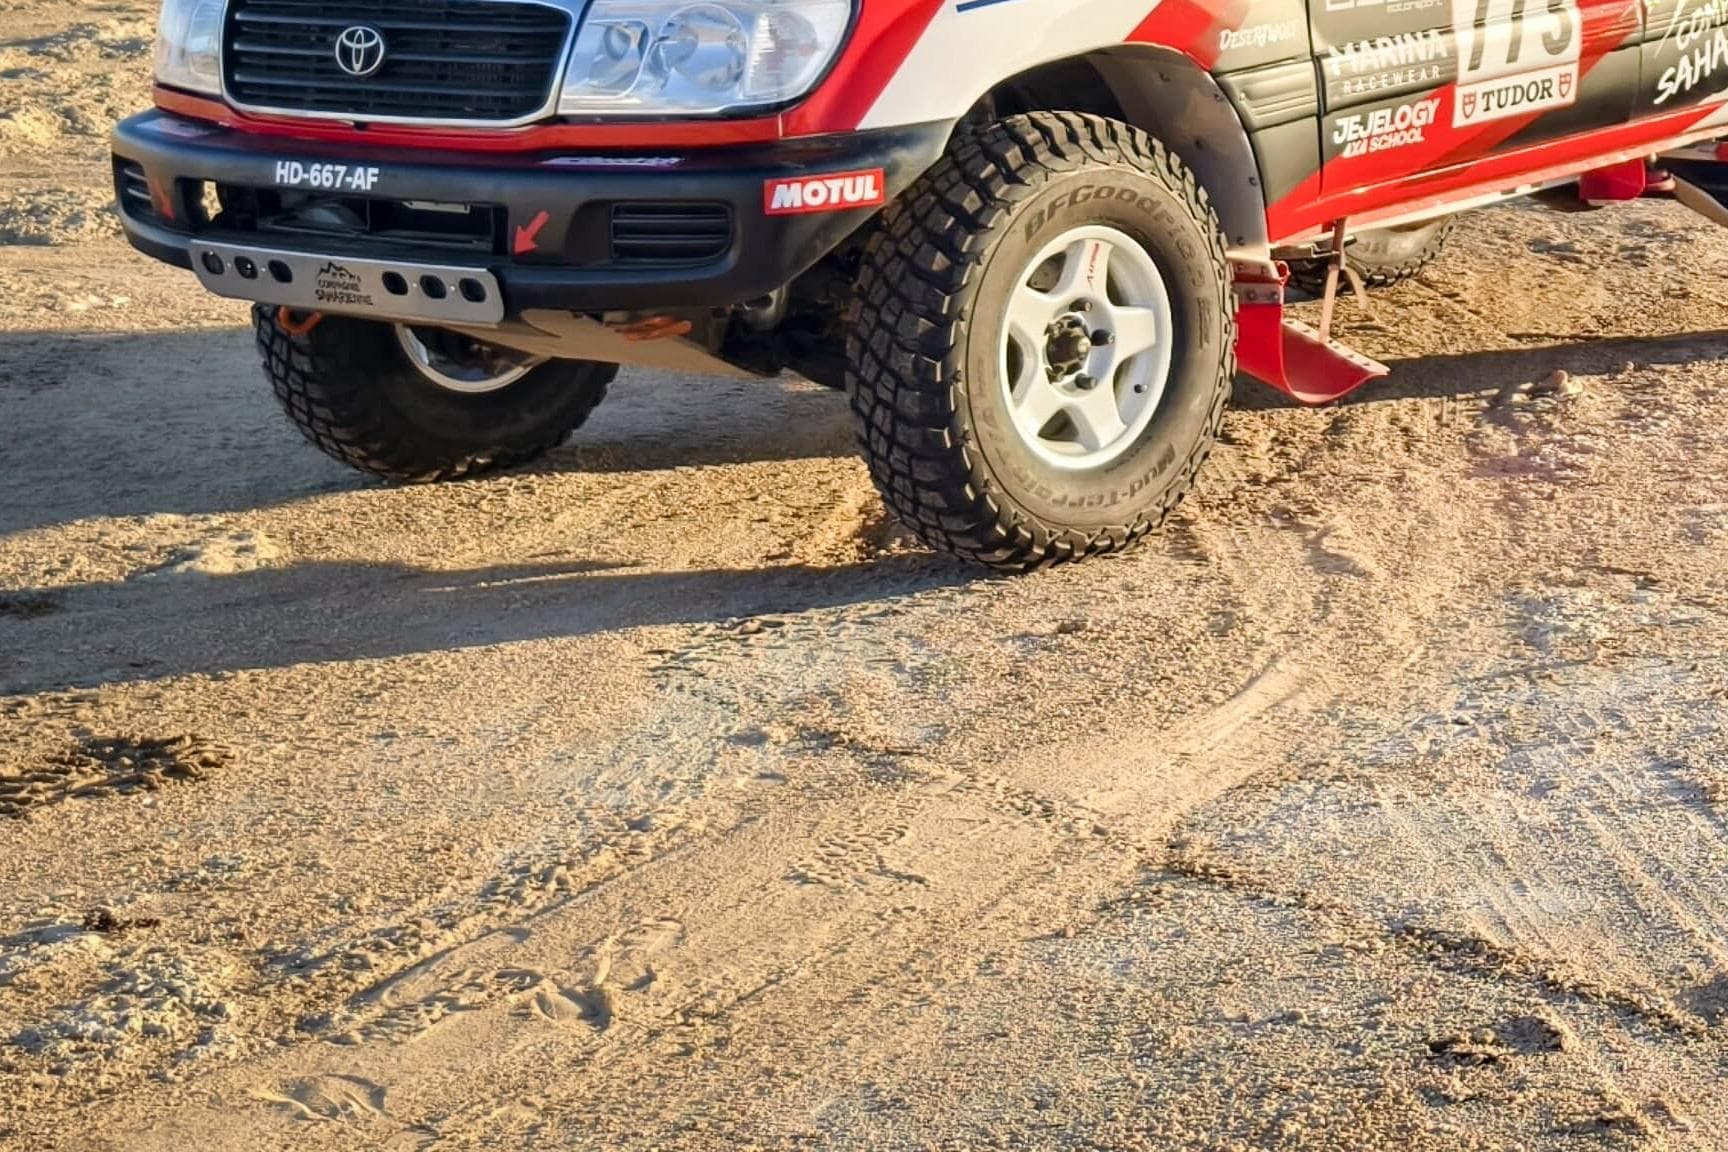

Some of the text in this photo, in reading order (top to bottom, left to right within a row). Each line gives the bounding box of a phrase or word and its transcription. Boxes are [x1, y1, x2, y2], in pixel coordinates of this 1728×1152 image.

[1328, 28, 1448, 76] MARINA
[1343, 65, 1441, 94] RACEWEAR
[1481, 78, 1554, 113] TUDOR
[1332, 97, 1440, 144] JEJELOGY
[1369, 127, 1425, 153] SCHOOL
[276, 160, 379, 190] HD-667-AF
[771, 174, 880, 209] MOTUL
